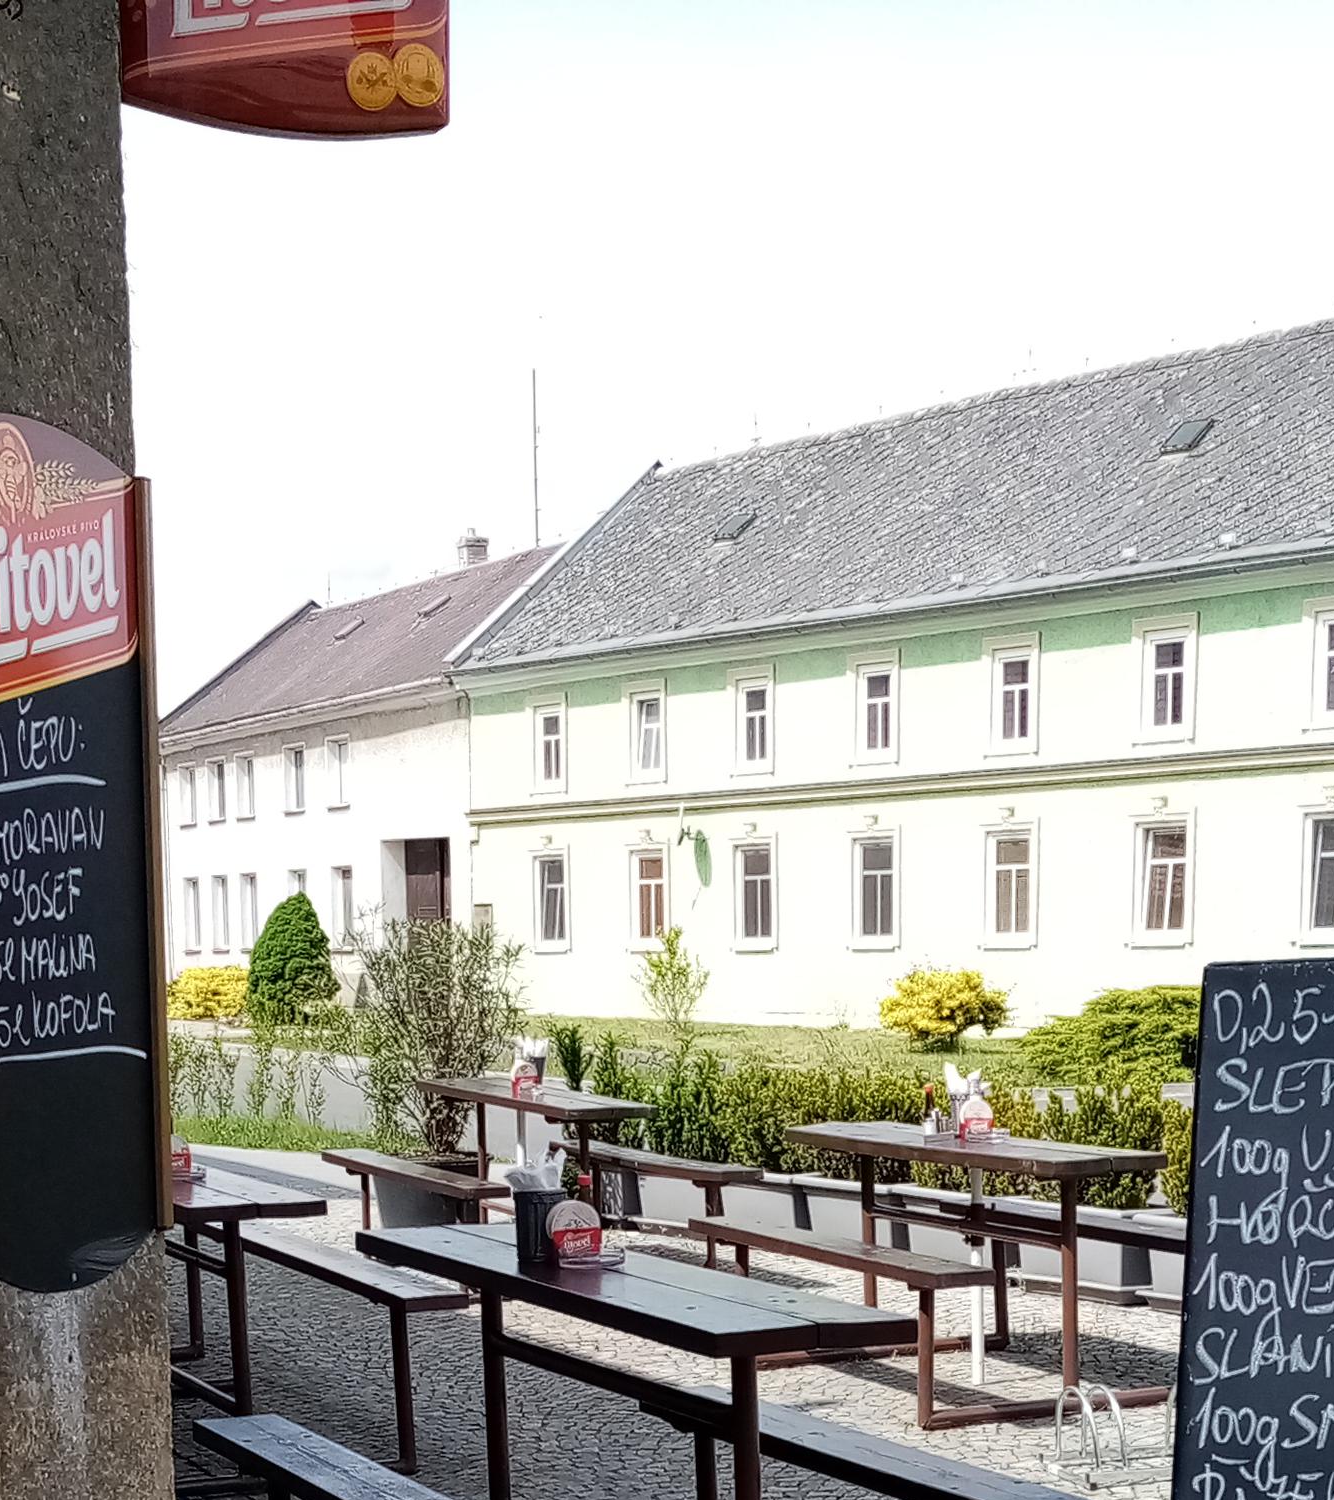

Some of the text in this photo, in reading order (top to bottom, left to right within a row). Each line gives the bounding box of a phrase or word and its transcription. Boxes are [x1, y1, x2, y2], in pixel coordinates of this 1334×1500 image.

[27, 518, 100, 544] KRÁLOVSKÉ PIVO
[17, 697, 86, 771] ČEPU:
[13, 867, 83, 928] JOSEF
[31, 990, 117, 1040] KOFOLA
[1200, 1124, 1290, 1203] 100g
[1192, 1252, 1282, 1335] 100g
[1189, 1386, 1280, 1491] 100g
